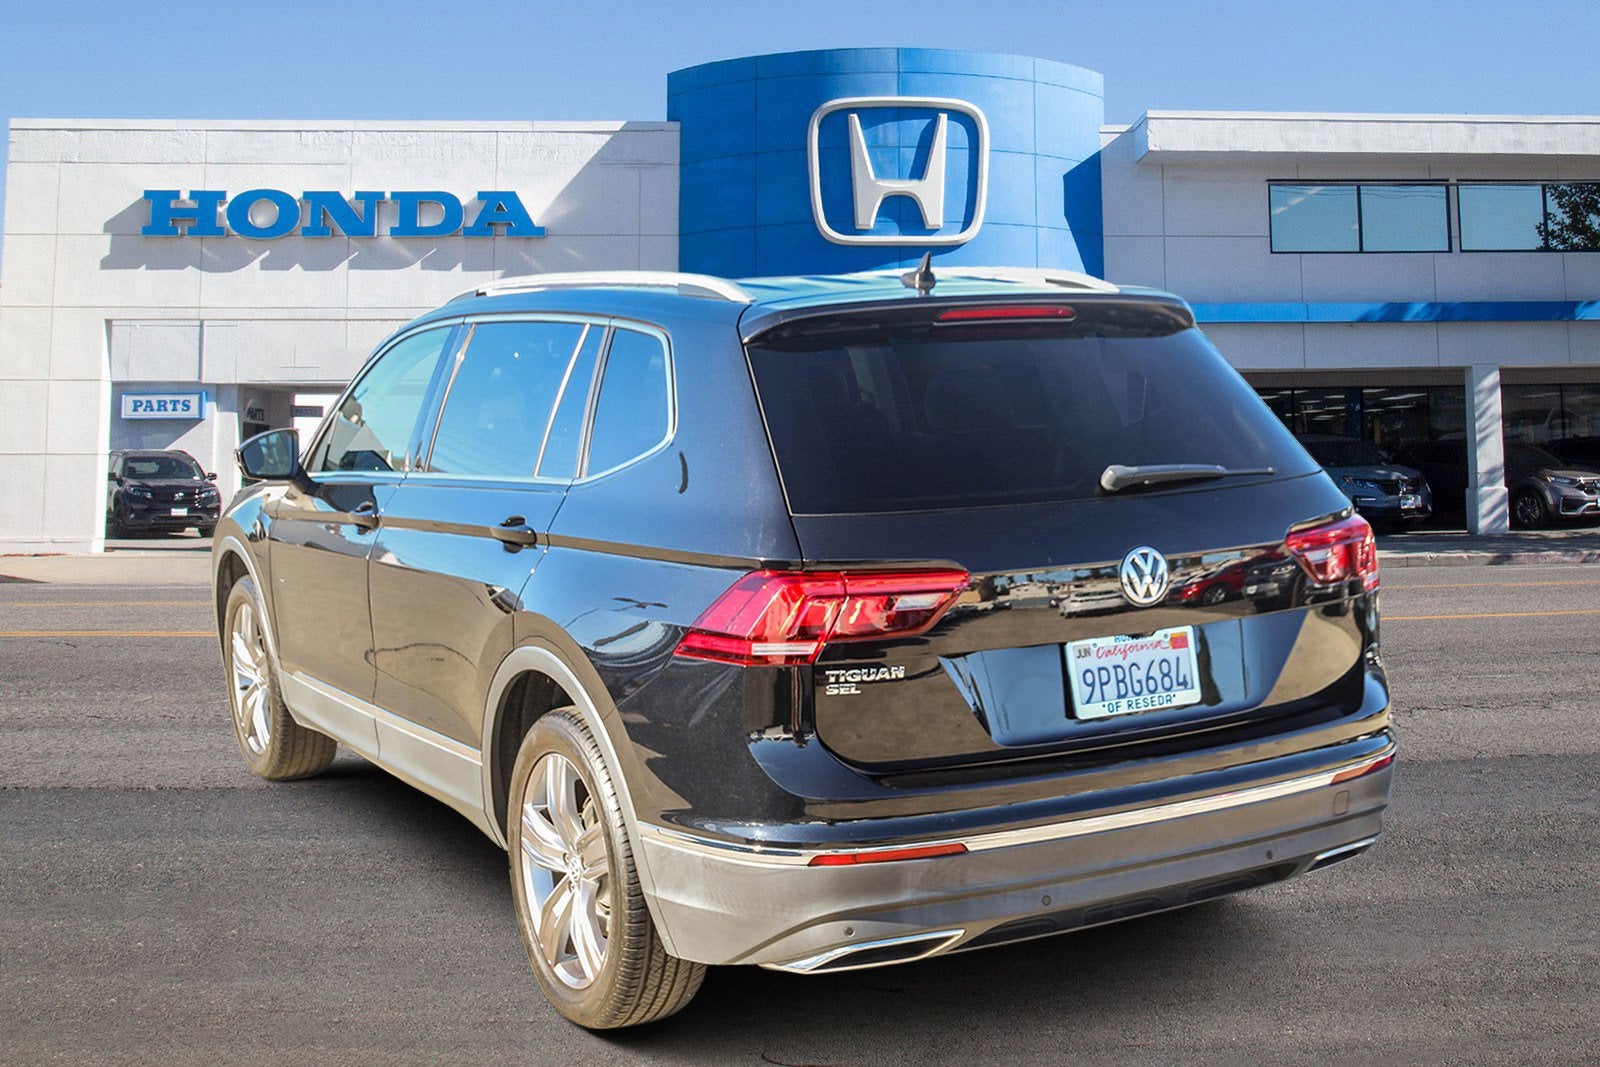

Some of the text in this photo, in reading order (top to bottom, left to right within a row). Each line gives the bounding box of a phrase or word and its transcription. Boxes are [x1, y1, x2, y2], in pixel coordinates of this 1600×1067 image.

[141, 189, 547, 239] HONDA
[132, 399, 191, 412] PARTS
[1121, 546, 1168, 604] VW
[1096, 638, 1170, 660] California
[825, 666, 906, 683] TIGUAN
[1082, 657, 1189, 704] 9PBG684
[825, 683, 862, 696] SEL
[1107, 694, 1174, 713] OF RESEDA
